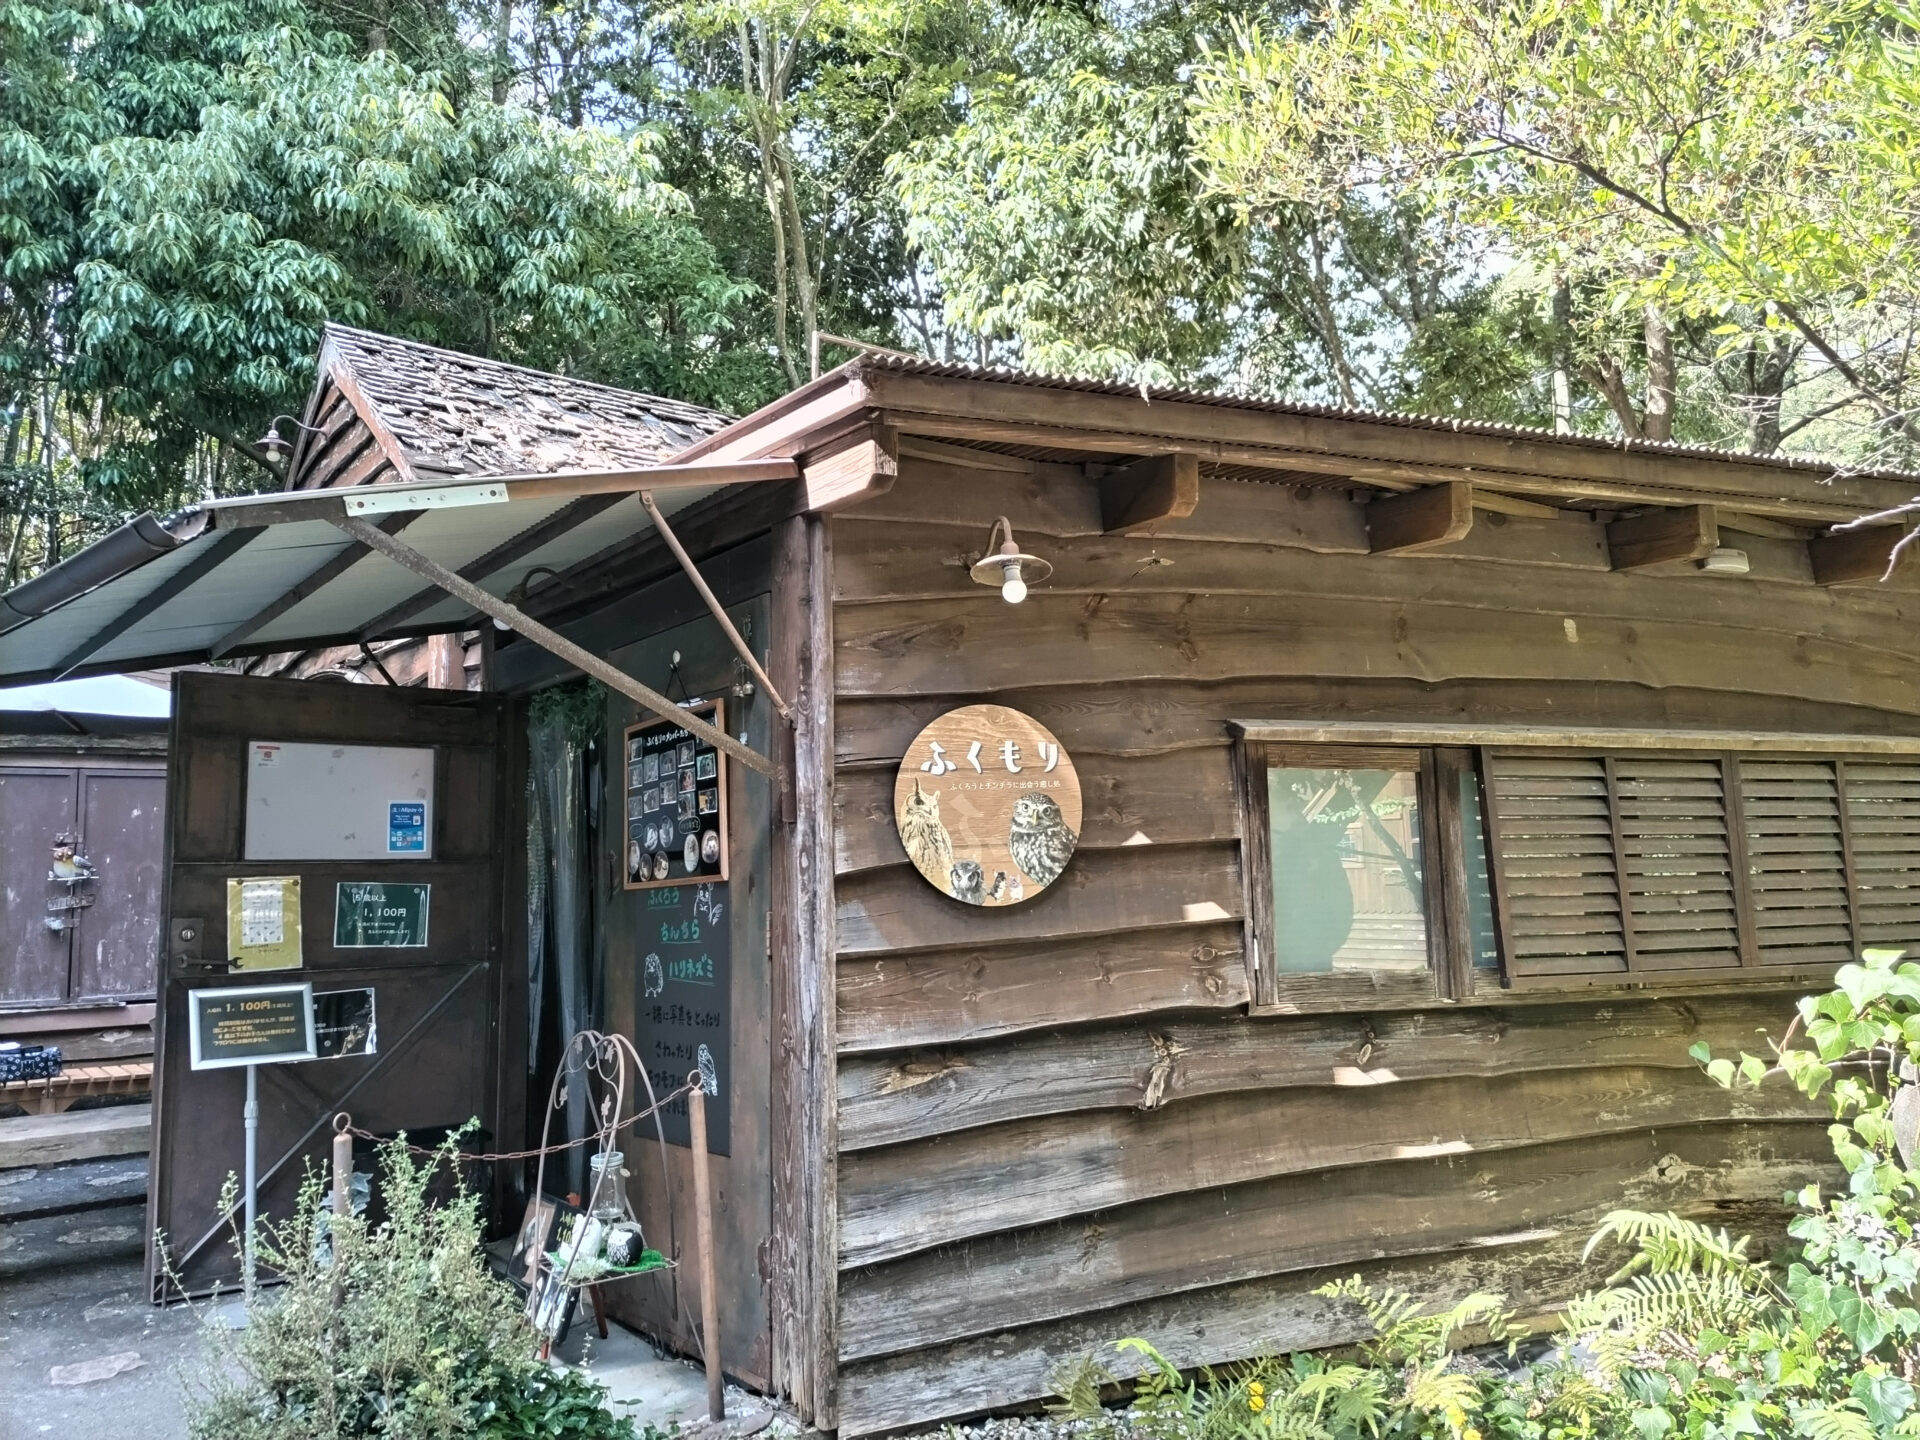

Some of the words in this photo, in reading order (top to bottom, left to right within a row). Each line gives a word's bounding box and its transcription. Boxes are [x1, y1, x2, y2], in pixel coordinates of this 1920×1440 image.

[920, 741, 1059, 775] ふくもり
[949, 780, 1061, 791] ふくろうとチンチラに出会う癒し処
[648, 887, 680, 905] ふくろう
[661, 919, 700, 941] ちんちら
[668, 953, 713, 979] ハリネズミ
[645, 1004, 720, 1027] 一緒に写真をとったり
